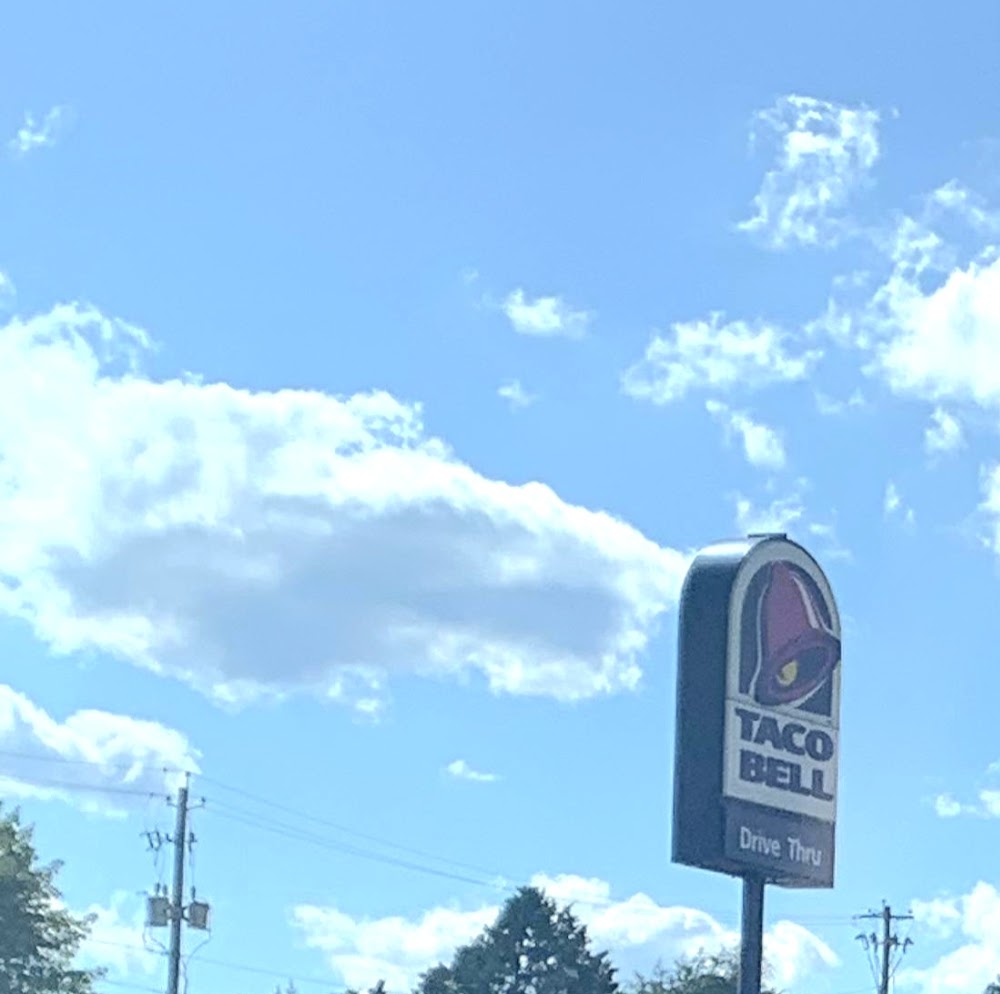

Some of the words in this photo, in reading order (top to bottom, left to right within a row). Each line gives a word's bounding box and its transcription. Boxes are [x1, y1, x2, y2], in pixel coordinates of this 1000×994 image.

[735, 708, 834, 762] TACO
[740, 749, 833, 802] BELL
[740, 826, 781, 857] Drive
[787, 836, 822, 867] Thru
